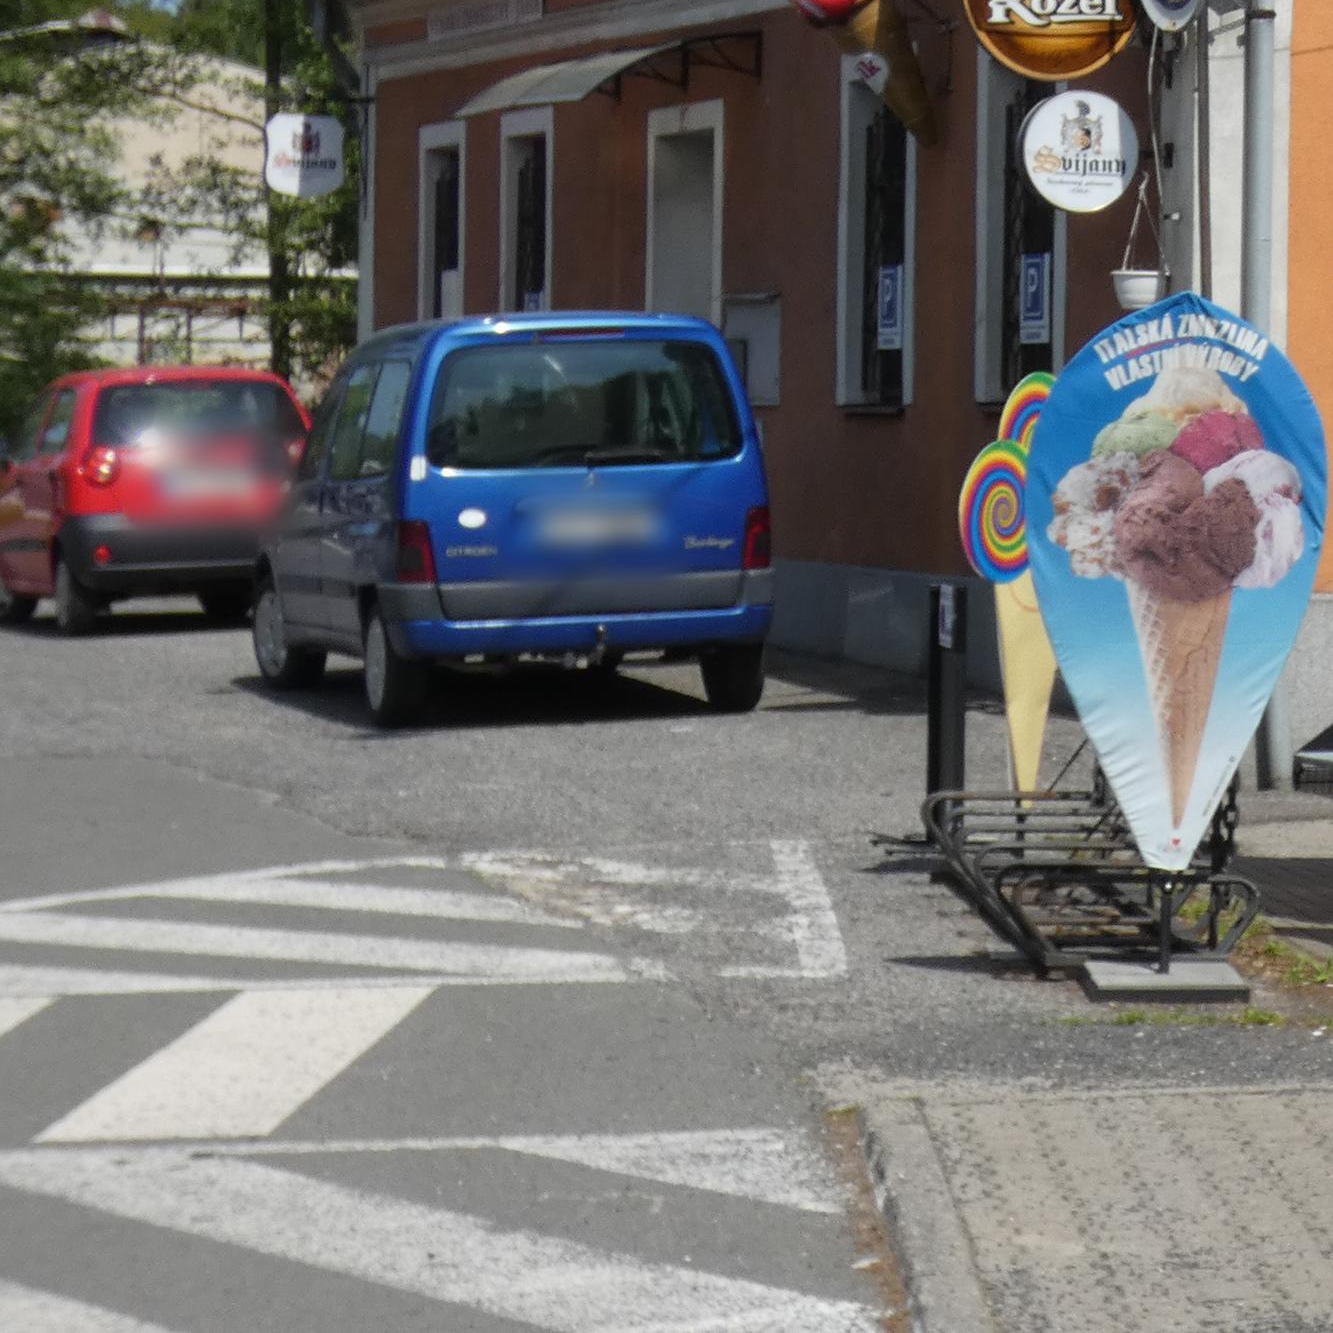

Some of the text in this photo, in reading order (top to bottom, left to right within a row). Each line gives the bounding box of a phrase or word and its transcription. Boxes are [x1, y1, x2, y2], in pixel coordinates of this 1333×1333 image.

[1033, 146, 1126, 176] Svijany
[1093, 313, 1269, 364] ITALSKÁ ZMRZLINA
[1103, 344, 1182, 391] VLASTNÍ
